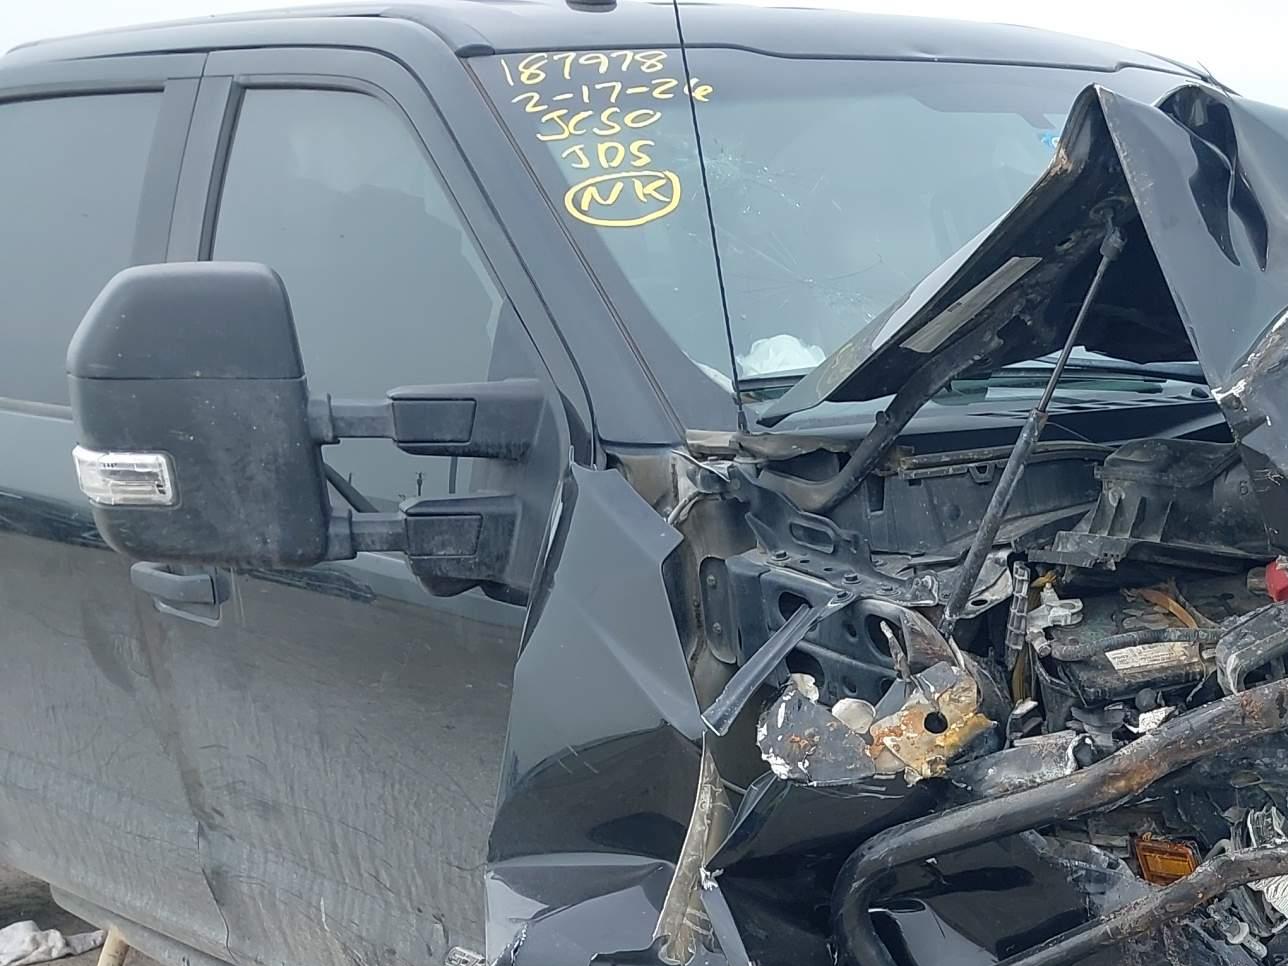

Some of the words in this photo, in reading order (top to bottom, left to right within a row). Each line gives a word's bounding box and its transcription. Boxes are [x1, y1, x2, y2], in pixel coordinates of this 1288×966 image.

[500, 50, 668, 86] 187978
[511, 77, 714, 113] 2-17-26
[536, 107, 662, 141] JCSO
[561, 140, 656, 169] JDS
[580, 177, 671, 212] NK
